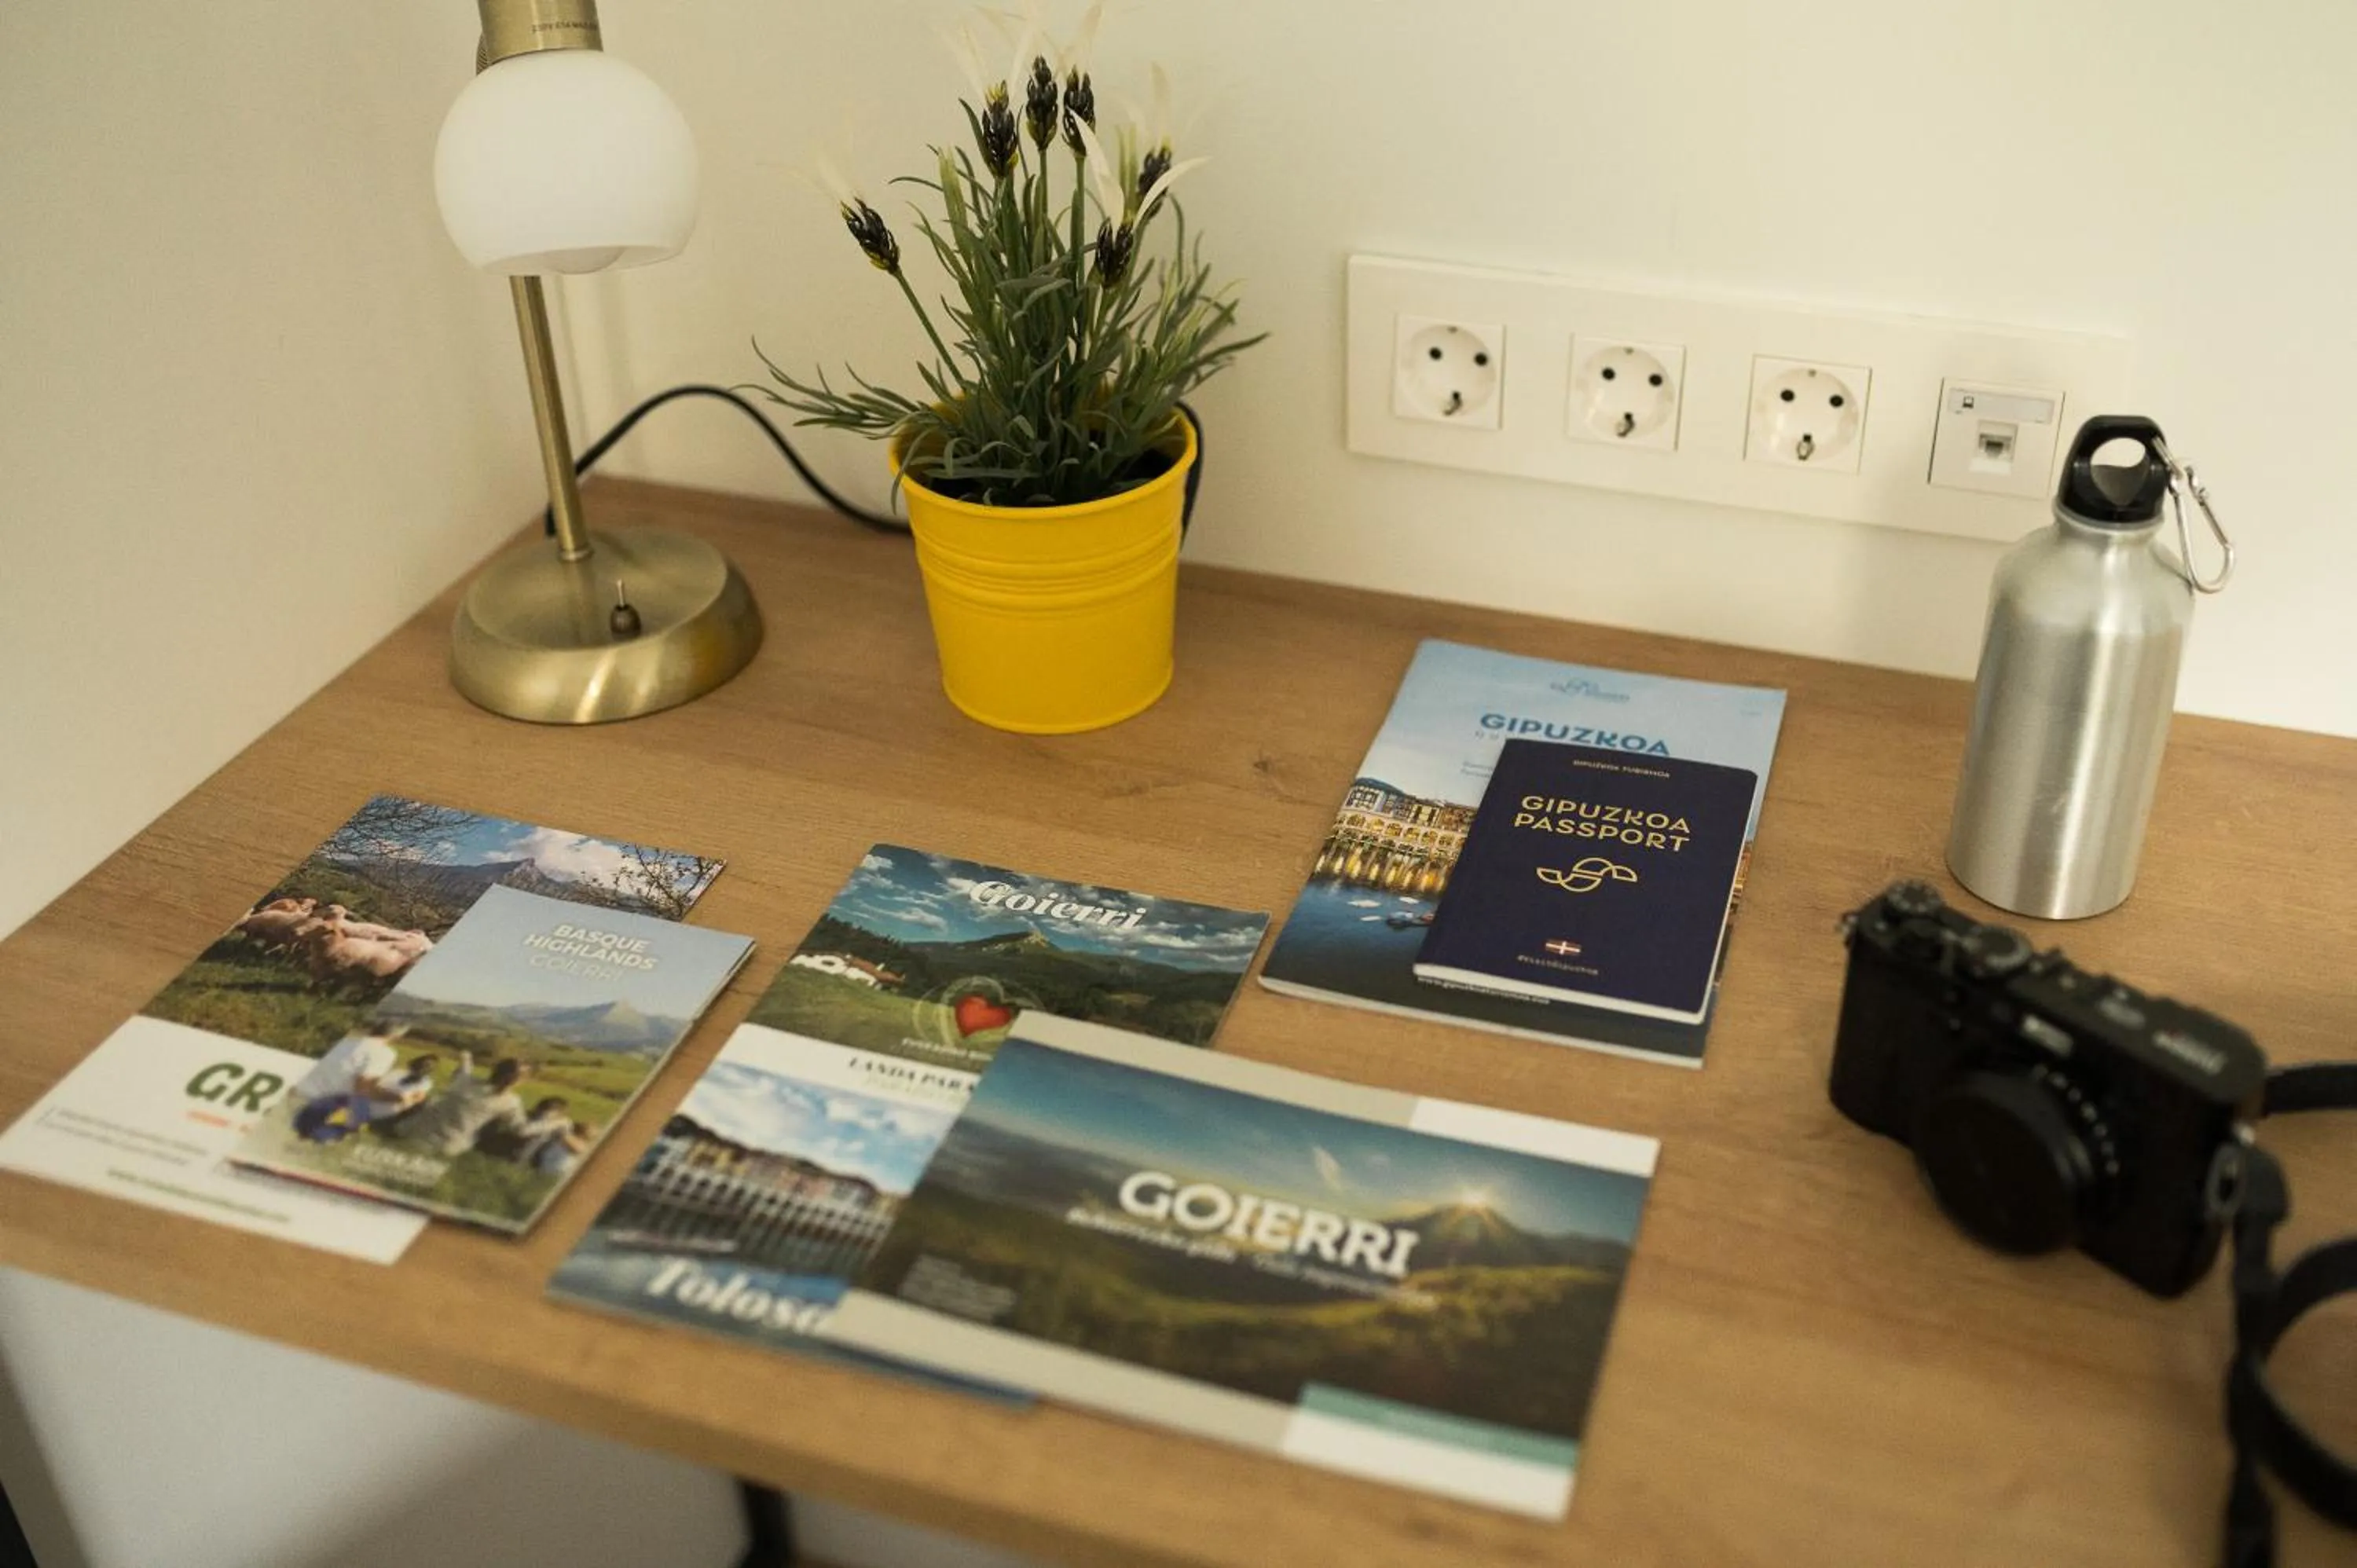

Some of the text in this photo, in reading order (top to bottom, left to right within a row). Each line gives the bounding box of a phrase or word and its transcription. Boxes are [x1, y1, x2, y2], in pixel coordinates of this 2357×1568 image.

[1479, 713, 1671, 757] GIPUZKOA
[1514, 812, 1690, 852] PASSPORT
[1521, 795, 1690, 833] GIPUZKOA
[970, 881, 1146, 929] Goierri
[522, 933, 658, 970] HIGHLANDS
[553, 924, 653, 953] BASQUE
[185, 1062, 284, 1113] GR
[1118, 1171, 1420, 1280] GOIERRI
